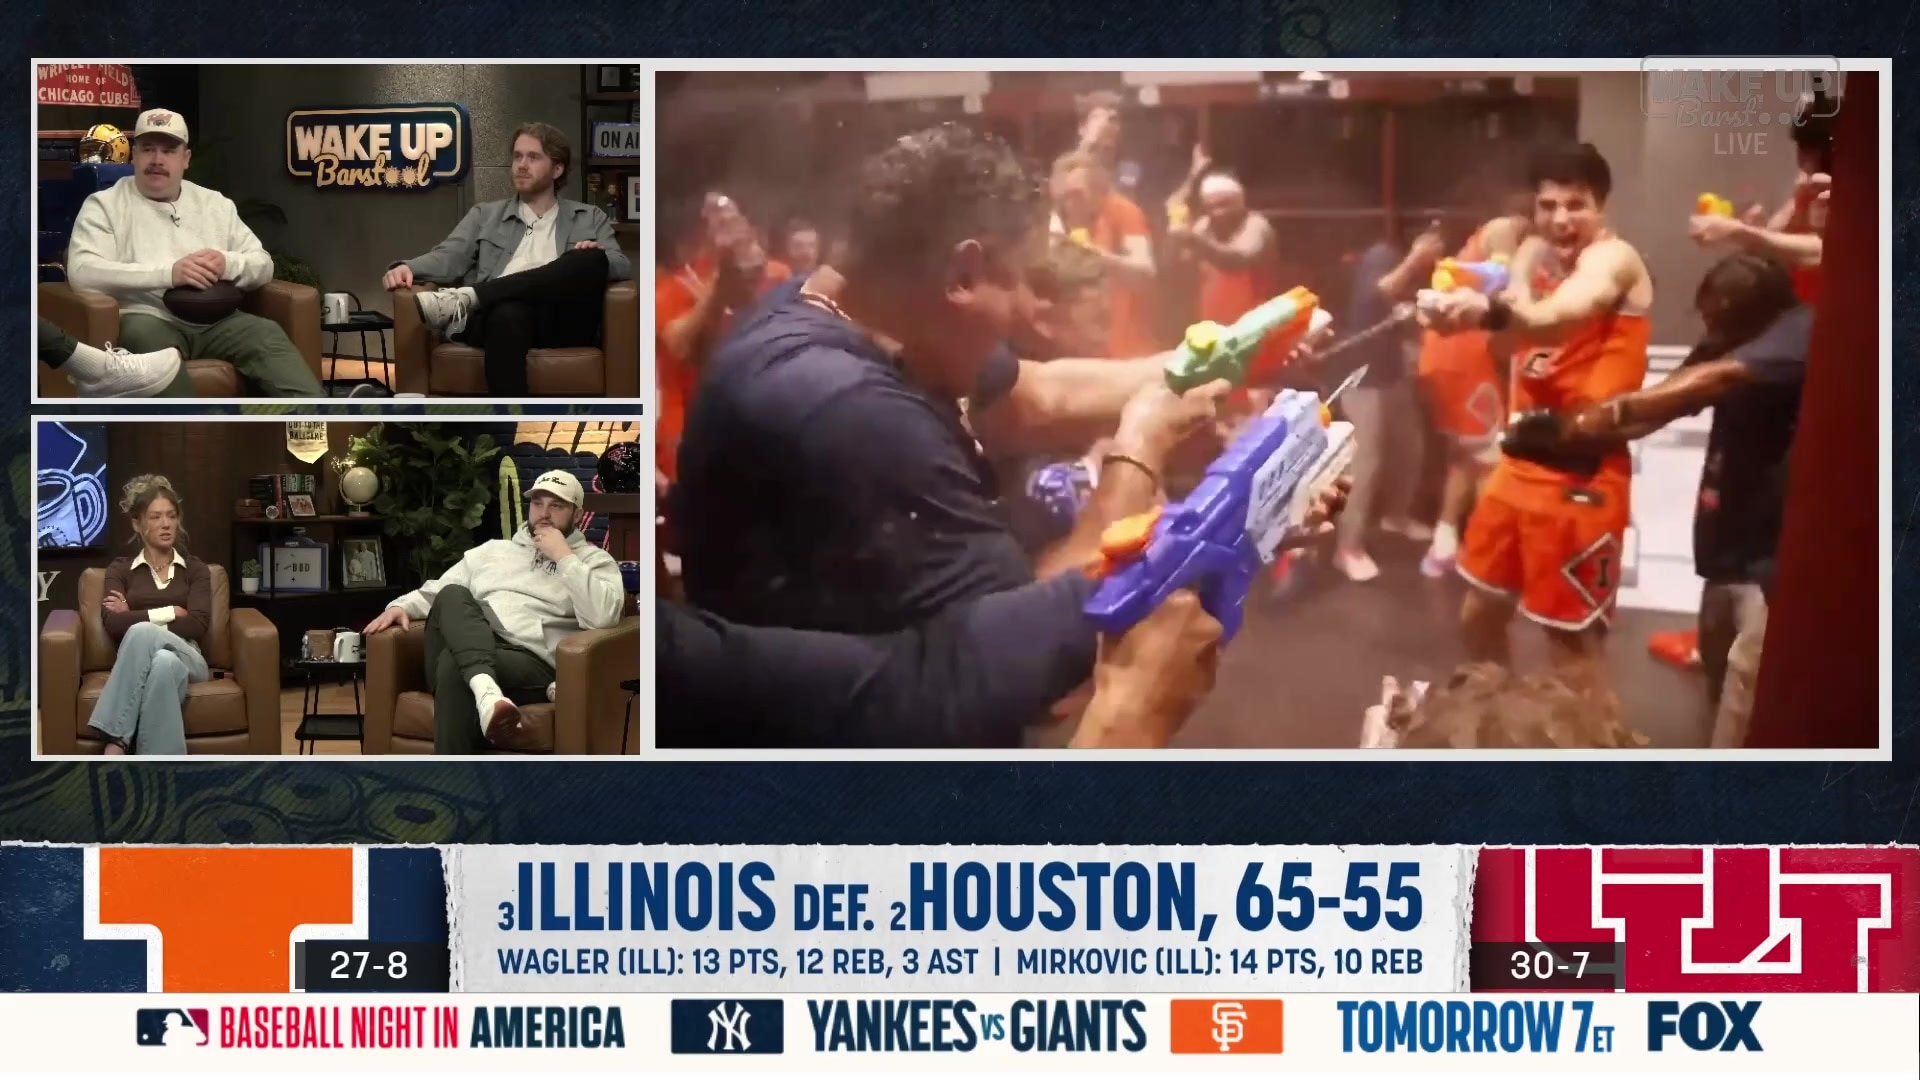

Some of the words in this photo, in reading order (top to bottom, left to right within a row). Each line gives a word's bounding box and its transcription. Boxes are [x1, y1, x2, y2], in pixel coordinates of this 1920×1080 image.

[66, 74, 90, 84] HOME
[96, 77, 106, 86] OF
[38, 87, 94, 104] CHICAGO
[100, 92, 129, 105] CUBS
[295, 124, 392, 161] WAKE
[400, 123, 453, 161] UP
[600, 131, 621, 149] ON
[289, 431, 324, 440] BALLGAME
